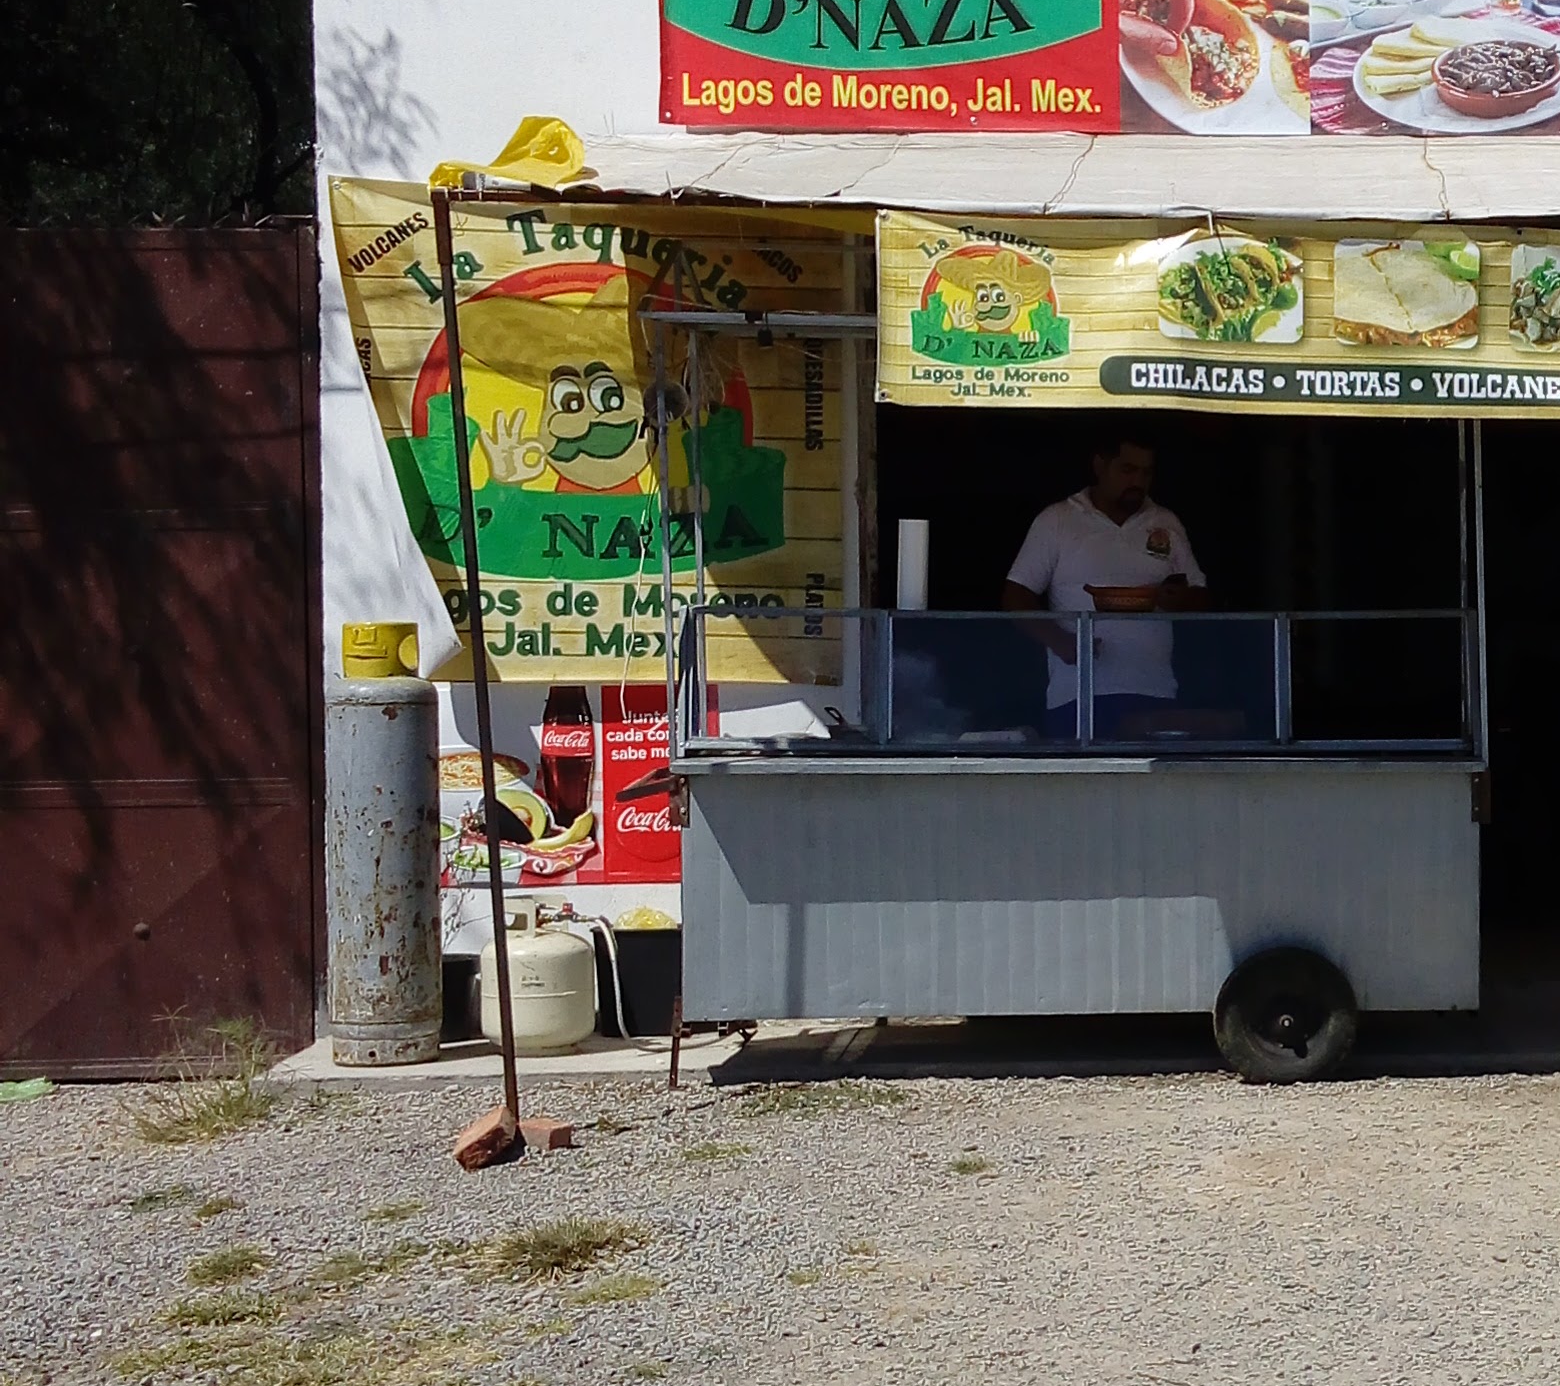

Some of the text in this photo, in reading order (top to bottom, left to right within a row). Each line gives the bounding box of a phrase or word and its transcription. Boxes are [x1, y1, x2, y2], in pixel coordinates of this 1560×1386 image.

[681, 72, 1102, 117] Lagos de Moreno, Jal. Mex.
[347, 212, 429, 273] VOLCANES
[918, 237, 950, 260] La
[752, 248, 803, 284] ACOS
[971, 336, 1065, 360] NAZA
[911, 365, 1070, 384] Lagos de Moreno
[1130, 362, 1265, 394] CHILACAS
[1296, 369, 1400, 397] TORTAS
[989, 384, 1032, 398] Mex.
[547, 583, 600, 617] de
[606, 728, 645, 743] cada
[611, 745, 648, 761] sabe
